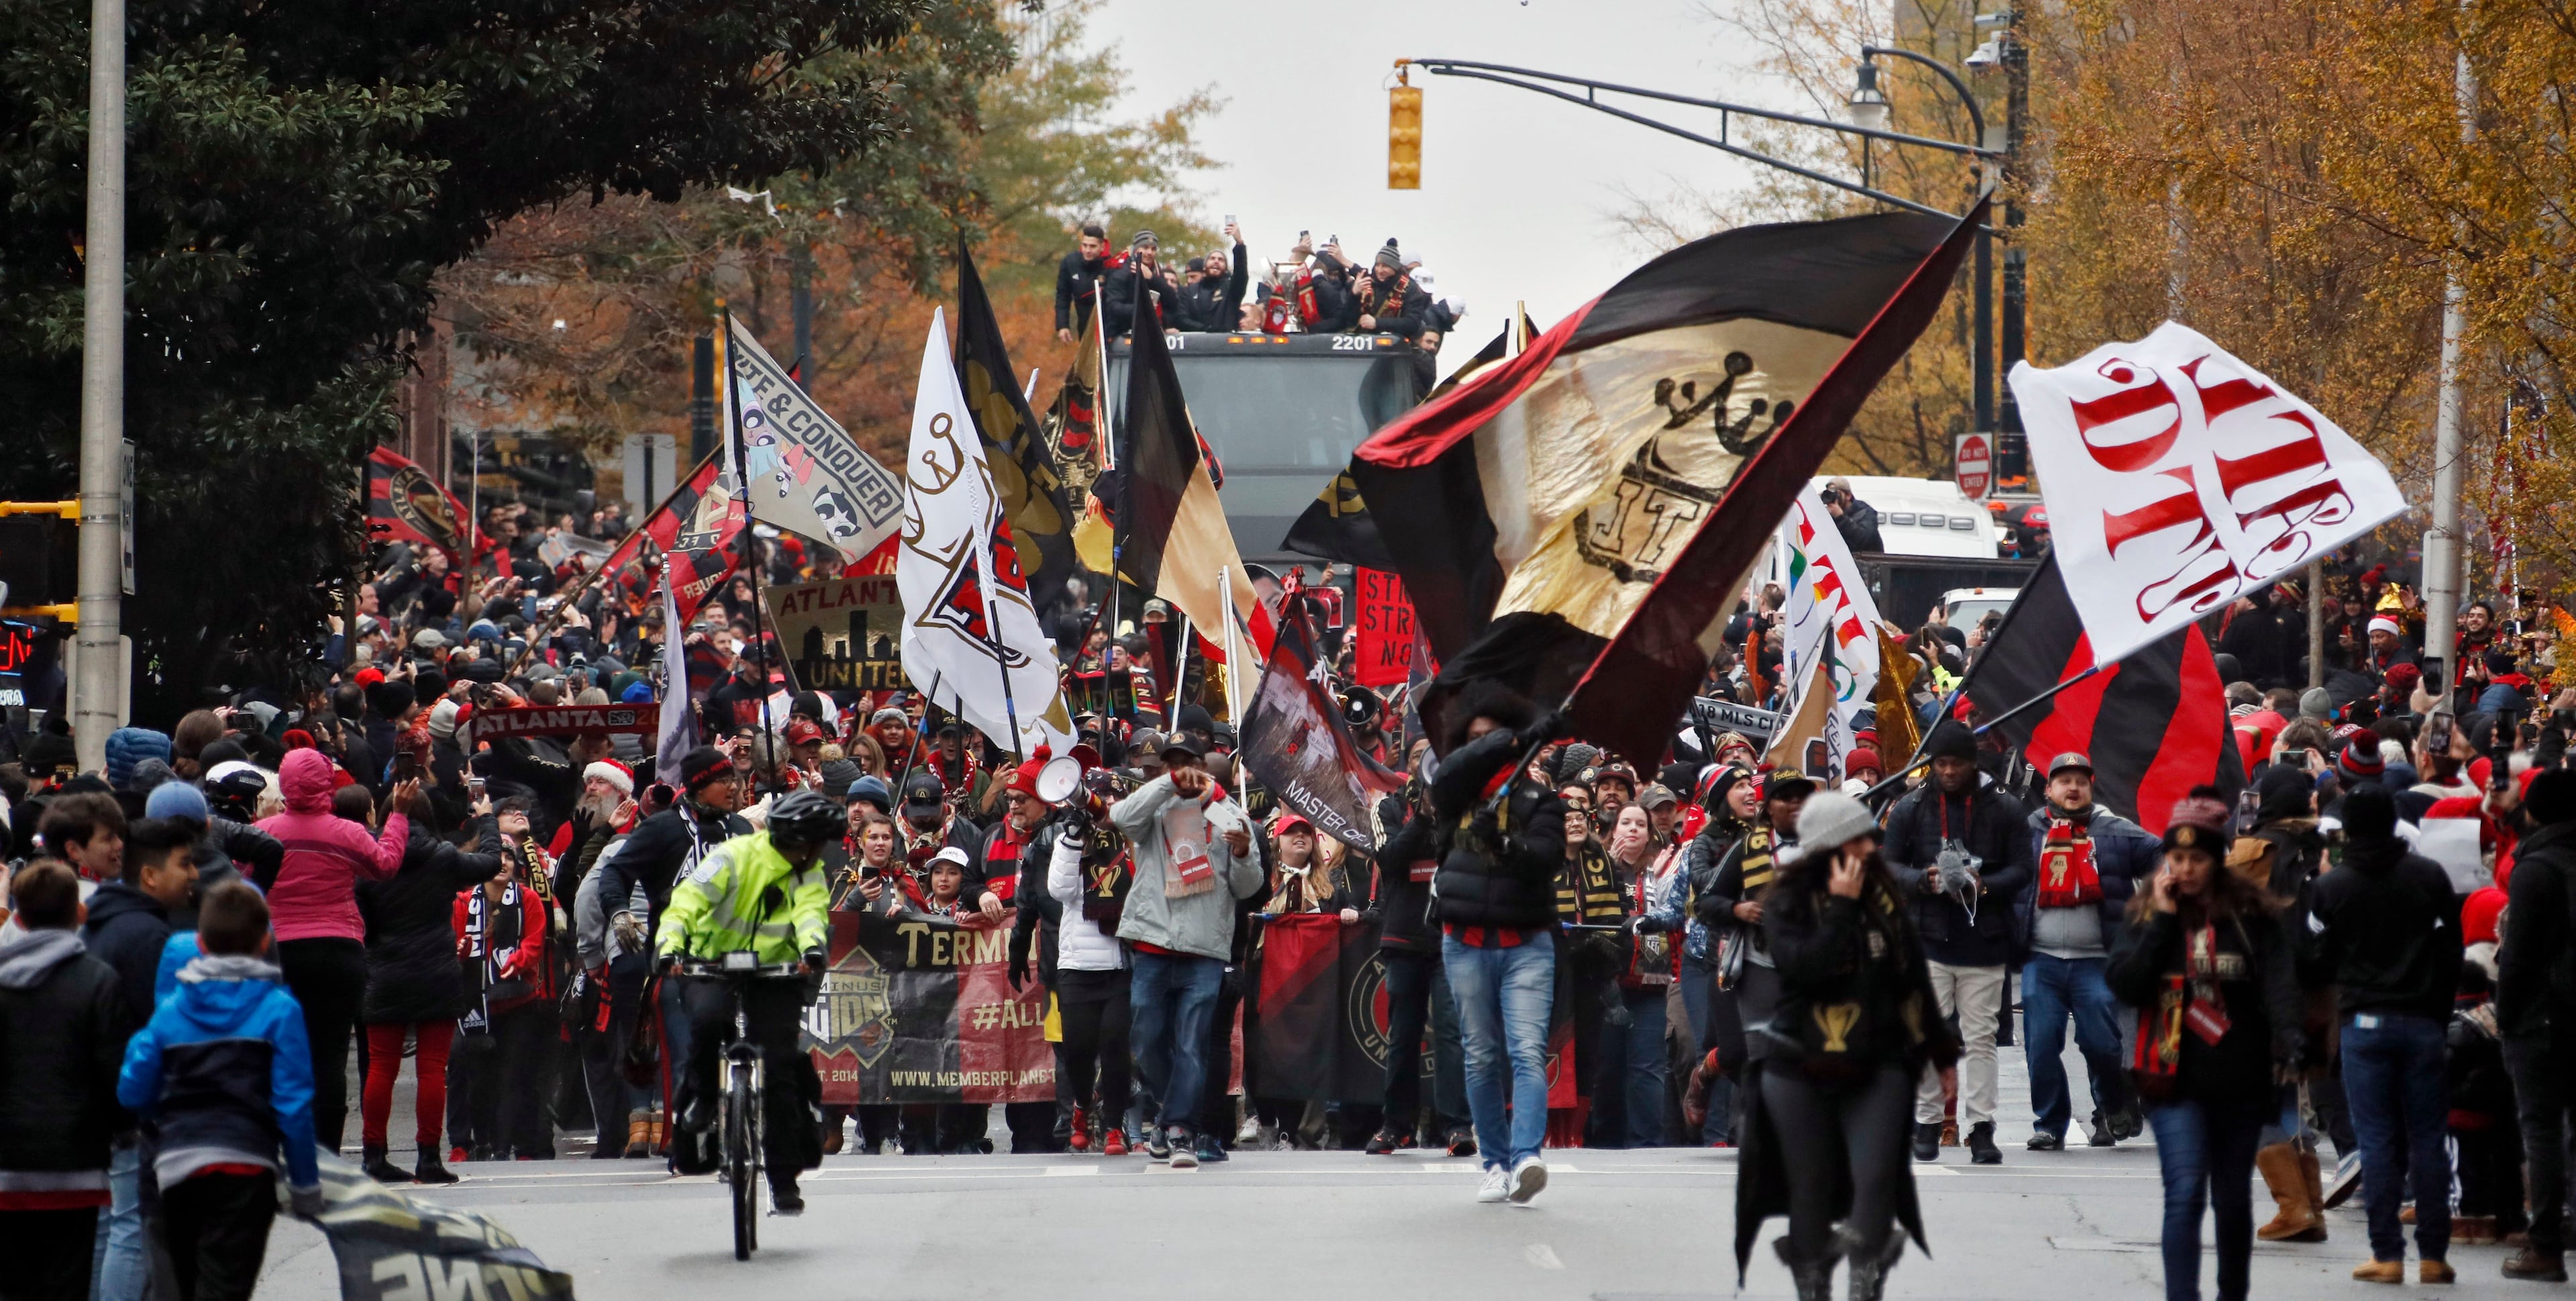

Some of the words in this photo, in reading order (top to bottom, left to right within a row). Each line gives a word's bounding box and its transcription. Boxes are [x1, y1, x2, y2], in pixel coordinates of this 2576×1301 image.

[1166, 335, 1185, 350] 01
[1332, 335, 1373, 350] 2201
[767, 393, 792, 419] &
[787, 409, 893, 516] CONQUER
[1962, 449, 1972, 459] DO
[1974, 447, 1986, 458] NOT
[1964, 476, 1984, 488] ENTER
[780, 580, 896, 617] ATLANT
[1364, 605, 1415, 635] STR
[1380, 639, 1412, 667] NO
[474, 710, 606, 737] ATLANTA
[1721, 709, 1754, 727] MLS
[1285, 780, 1346, 831] MASTER
[1343, 829, 1366, 843] OF
[1587, 858, 1609, 887] FC
[465, 898, 482, 957] MLS
[896, 923, 1037, 968] TERMI
[819, 982, 881, 992] MINUS
[463, 1019, 485, 1029] adidas
[800, 995, 885, 1045] GION
[832, 1070, 859, 1082] 2014
